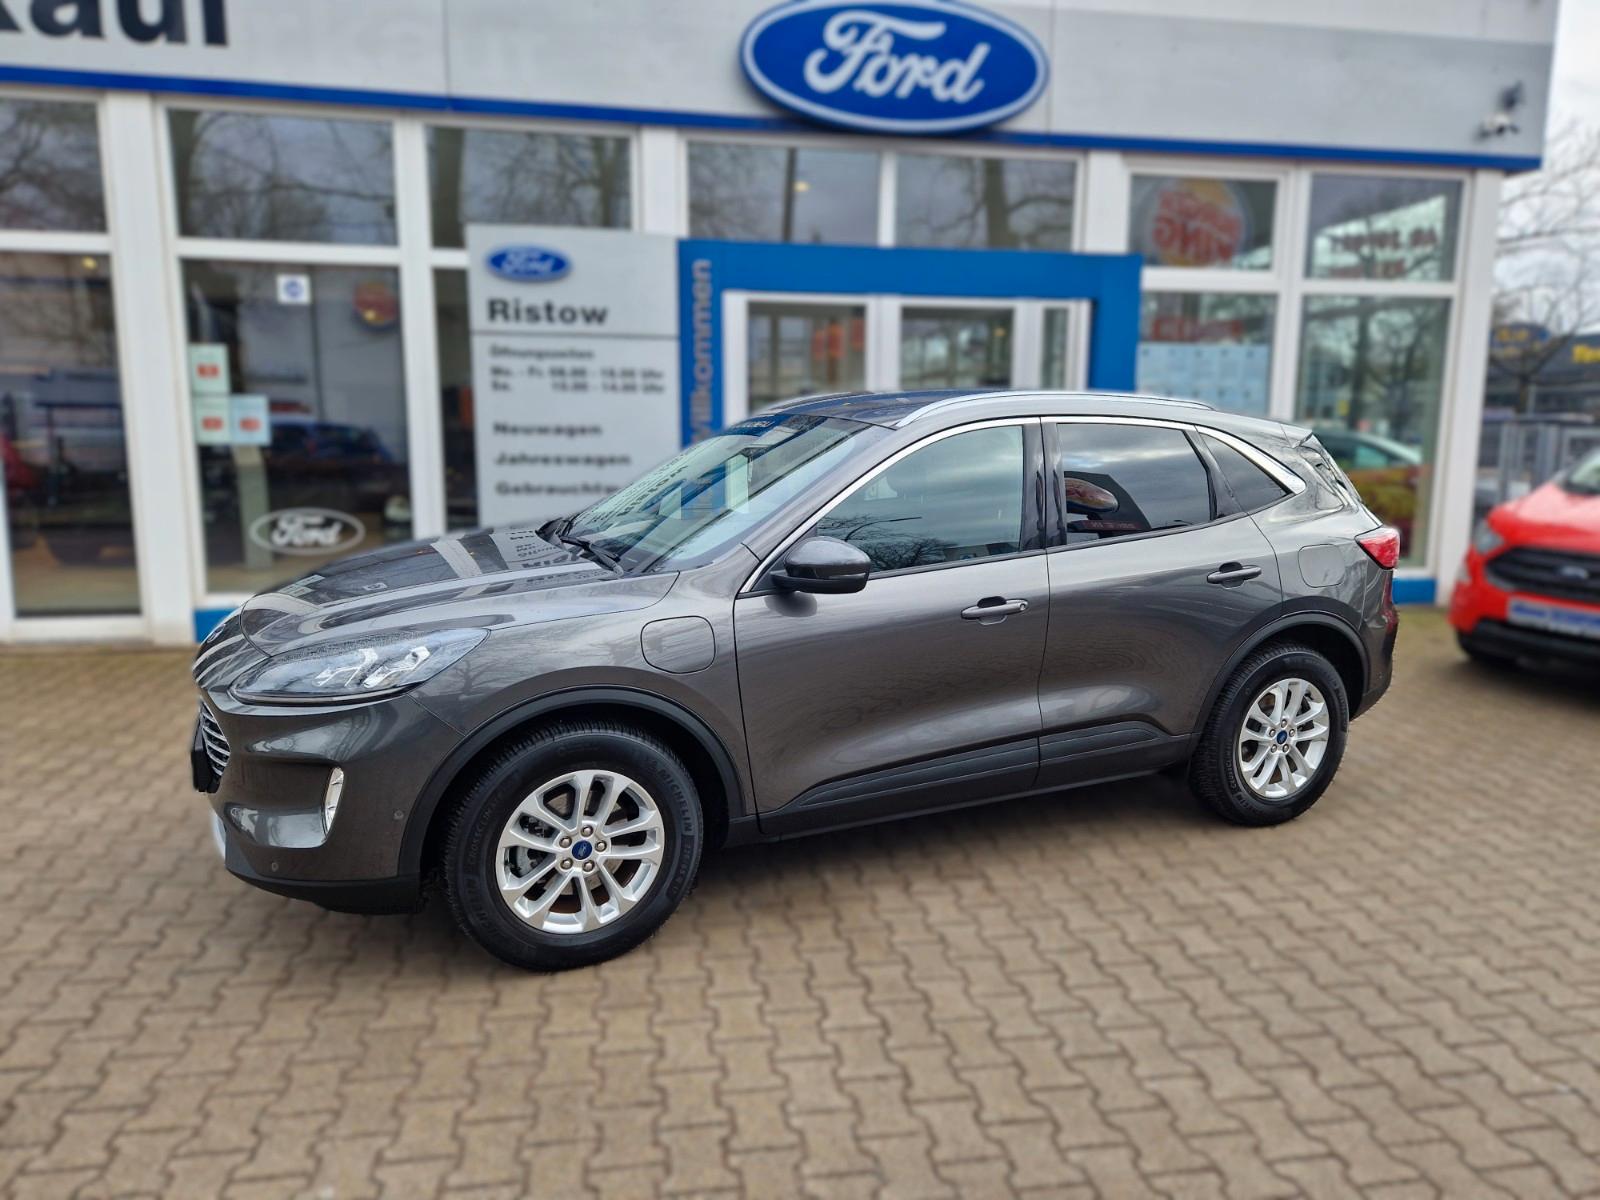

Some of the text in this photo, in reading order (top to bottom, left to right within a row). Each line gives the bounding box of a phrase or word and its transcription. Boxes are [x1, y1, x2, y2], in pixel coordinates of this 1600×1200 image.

[803, 9, 991, 103] Ford
[487, 299, 609, 325] Ristow
[494, 421, 602, 438] Neuwagen
[495, 453, 632, 469] Jahreswagen
[271, 511, 342, 547] Ford
[657, 768, 693, 833] MICHELIN
